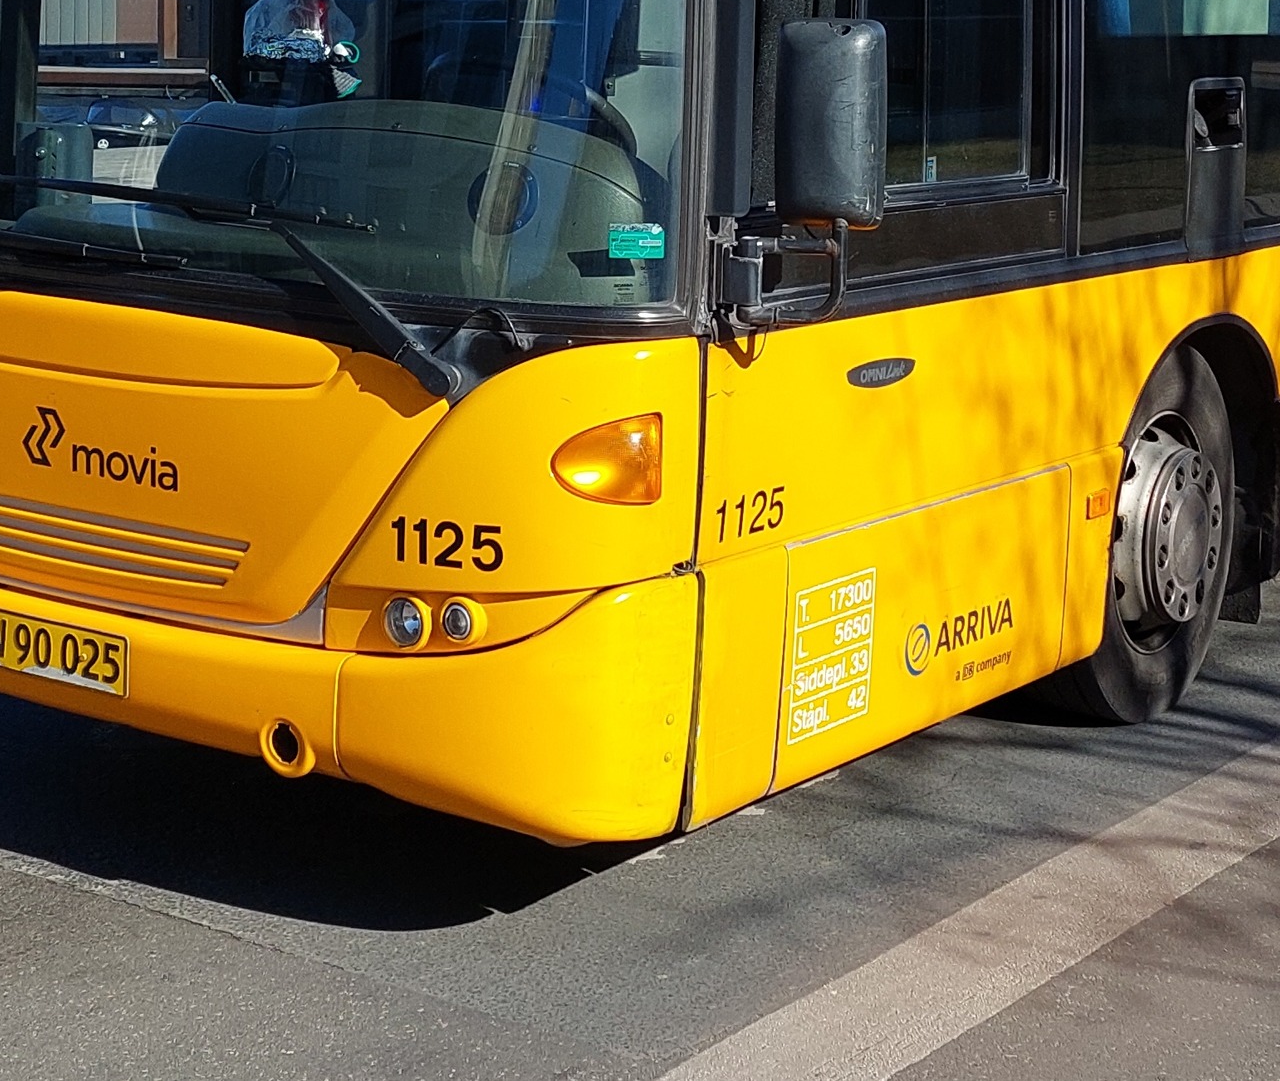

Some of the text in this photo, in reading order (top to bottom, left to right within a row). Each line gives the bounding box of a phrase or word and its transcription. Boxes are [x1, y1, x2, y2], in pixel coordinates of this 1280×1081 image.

[72, 446, 179, 492] movia
[715, 486, 785, 544] 1125
[390, 515, 504, 572] 1125
[829, 579, 872, 612] 17300
[797, 613, 870, 659] L 5650
[934, 598, 1014, 657] ARRIVA
[13, 623, 53, 669] 90
[60, 633, 121, 685] 025
[795, 649, 869, 696] Siddepl. 33
[976, 650, 1012, 673] company
[792, 685, 866, 733] Ståpl. 42
